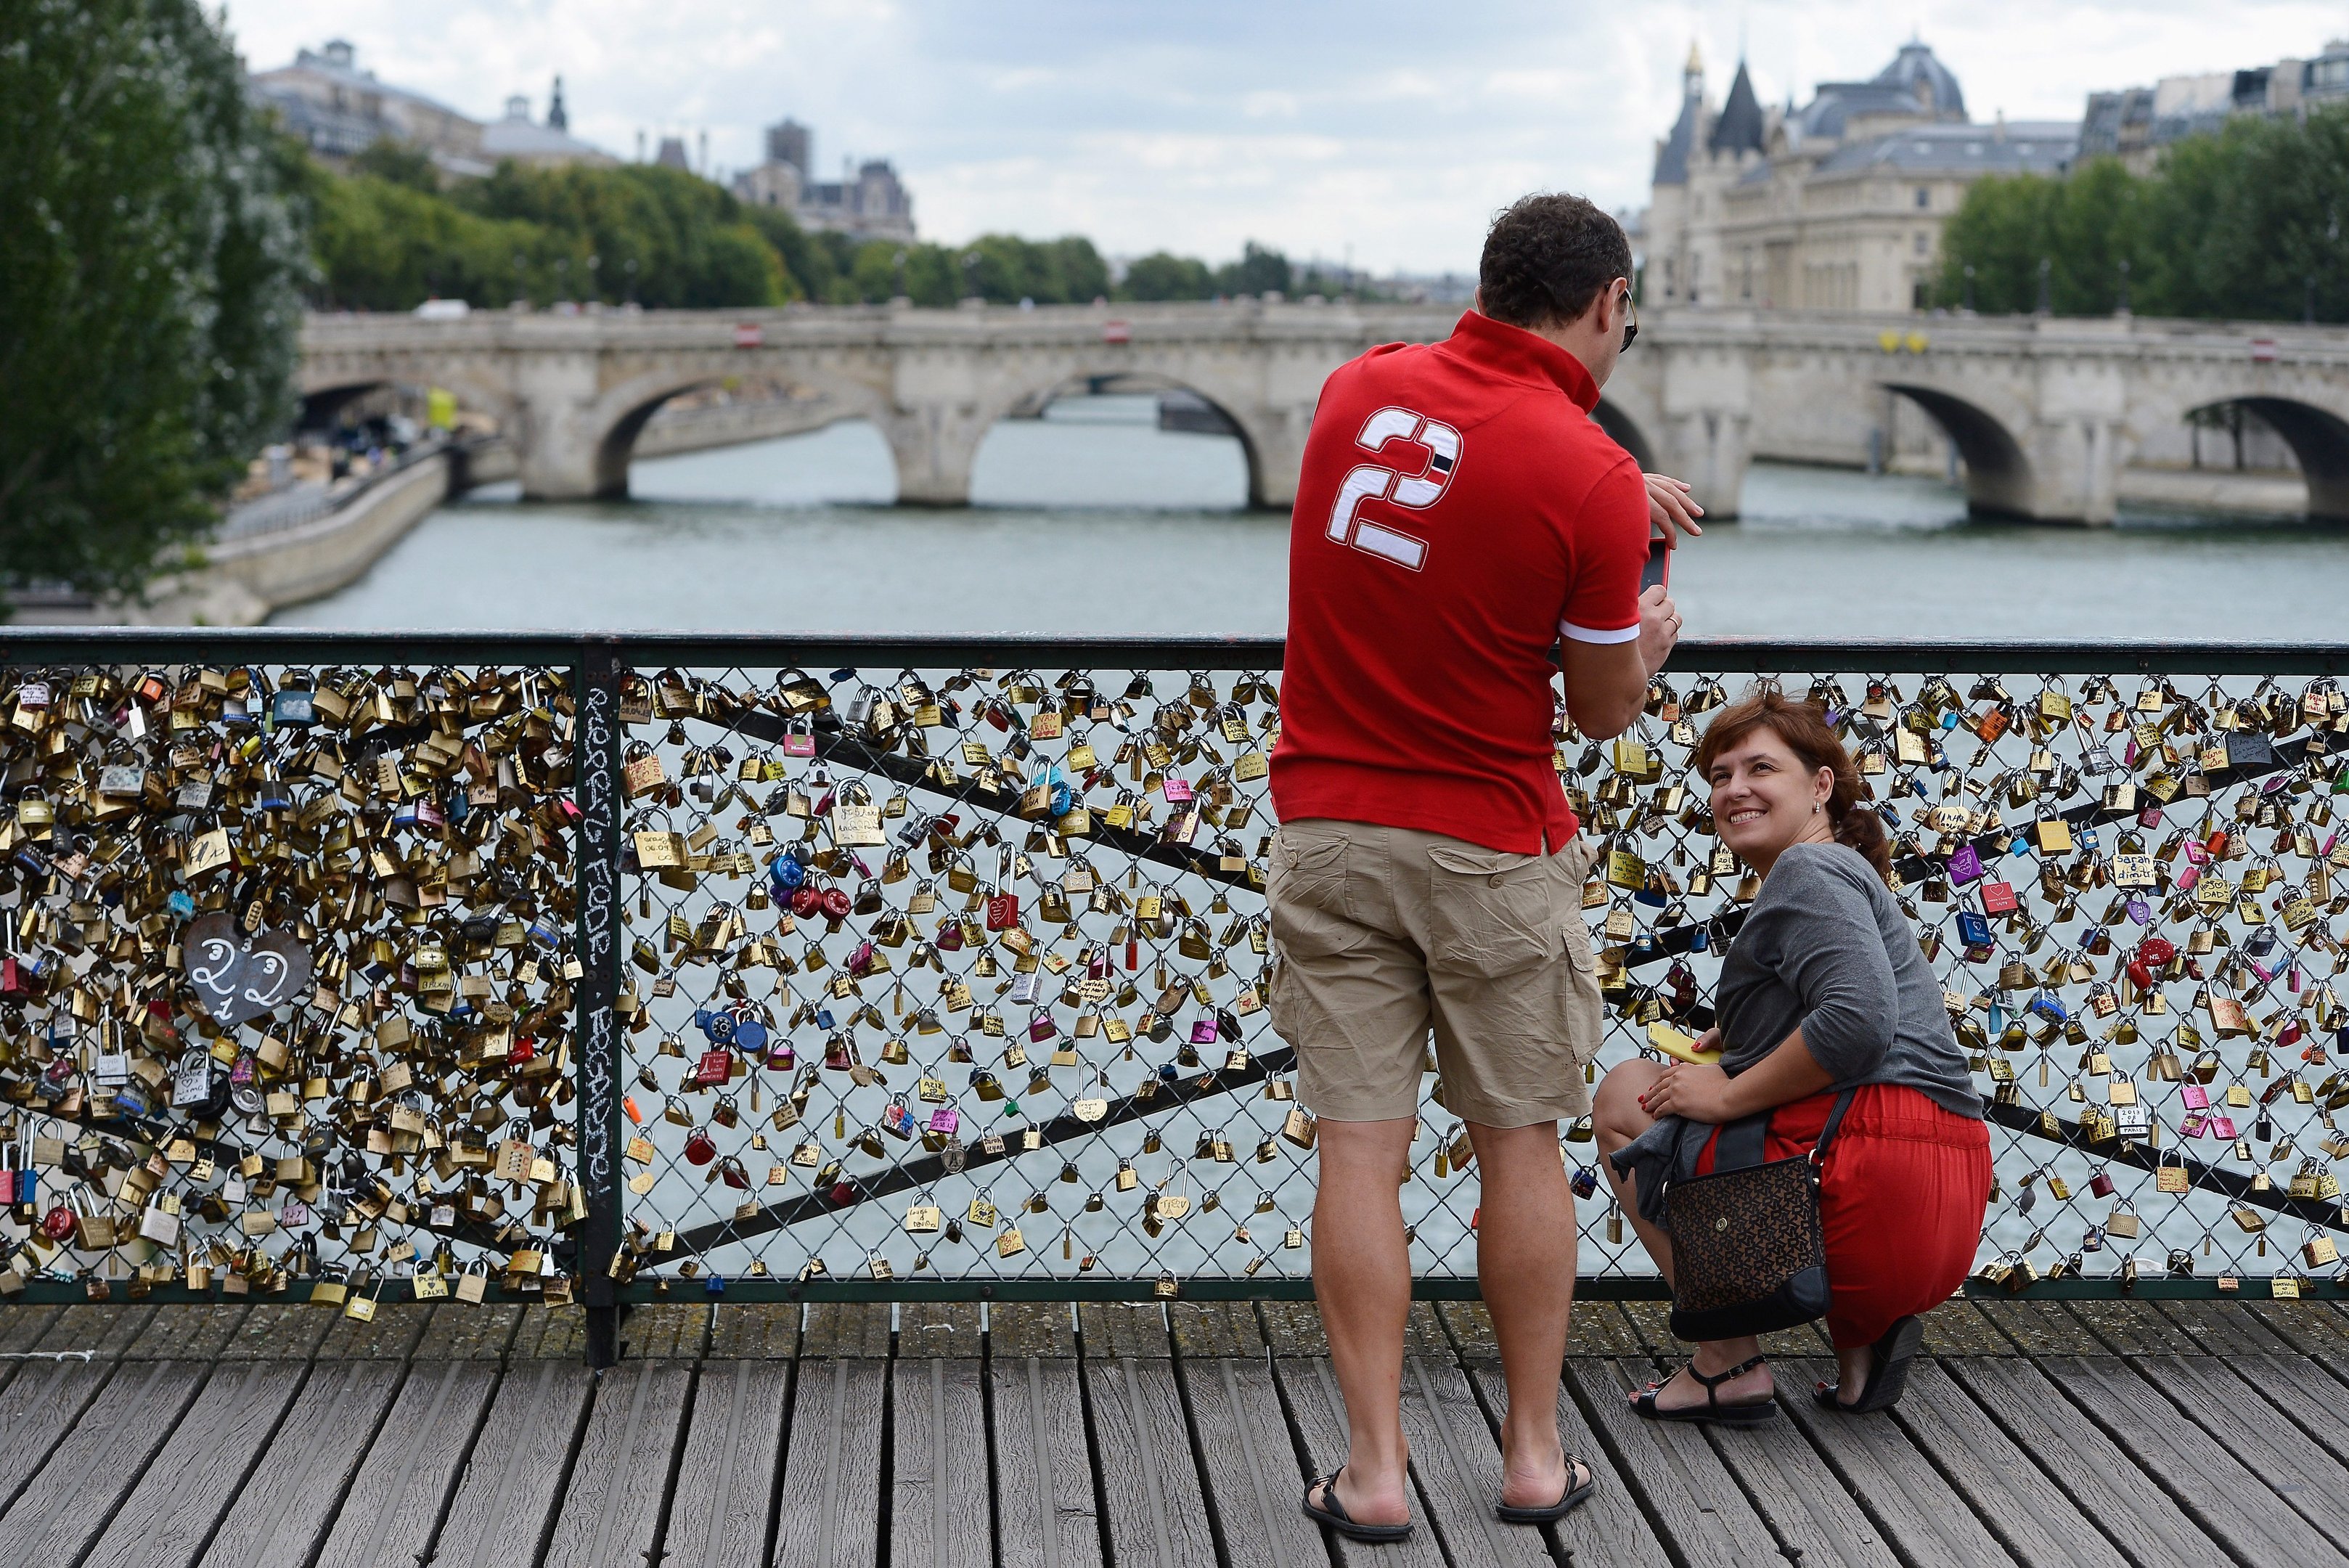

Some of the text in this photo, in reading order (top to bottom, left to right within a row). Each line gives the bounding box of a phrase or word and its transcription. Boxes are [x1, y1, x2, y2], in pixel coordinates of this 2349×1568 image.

[1325, 405, 1464, 572] 2
[1035, 713, 1058, 722] IVAN
[208, 944, 224, 961] 3
[241, 937, 253, 952] 3
[192, 938, 236, 995] 2
[263, 957, 278, 975] 3
[244, 950, 289, 1007] 2
[213, 996, 233, 1021] 1
